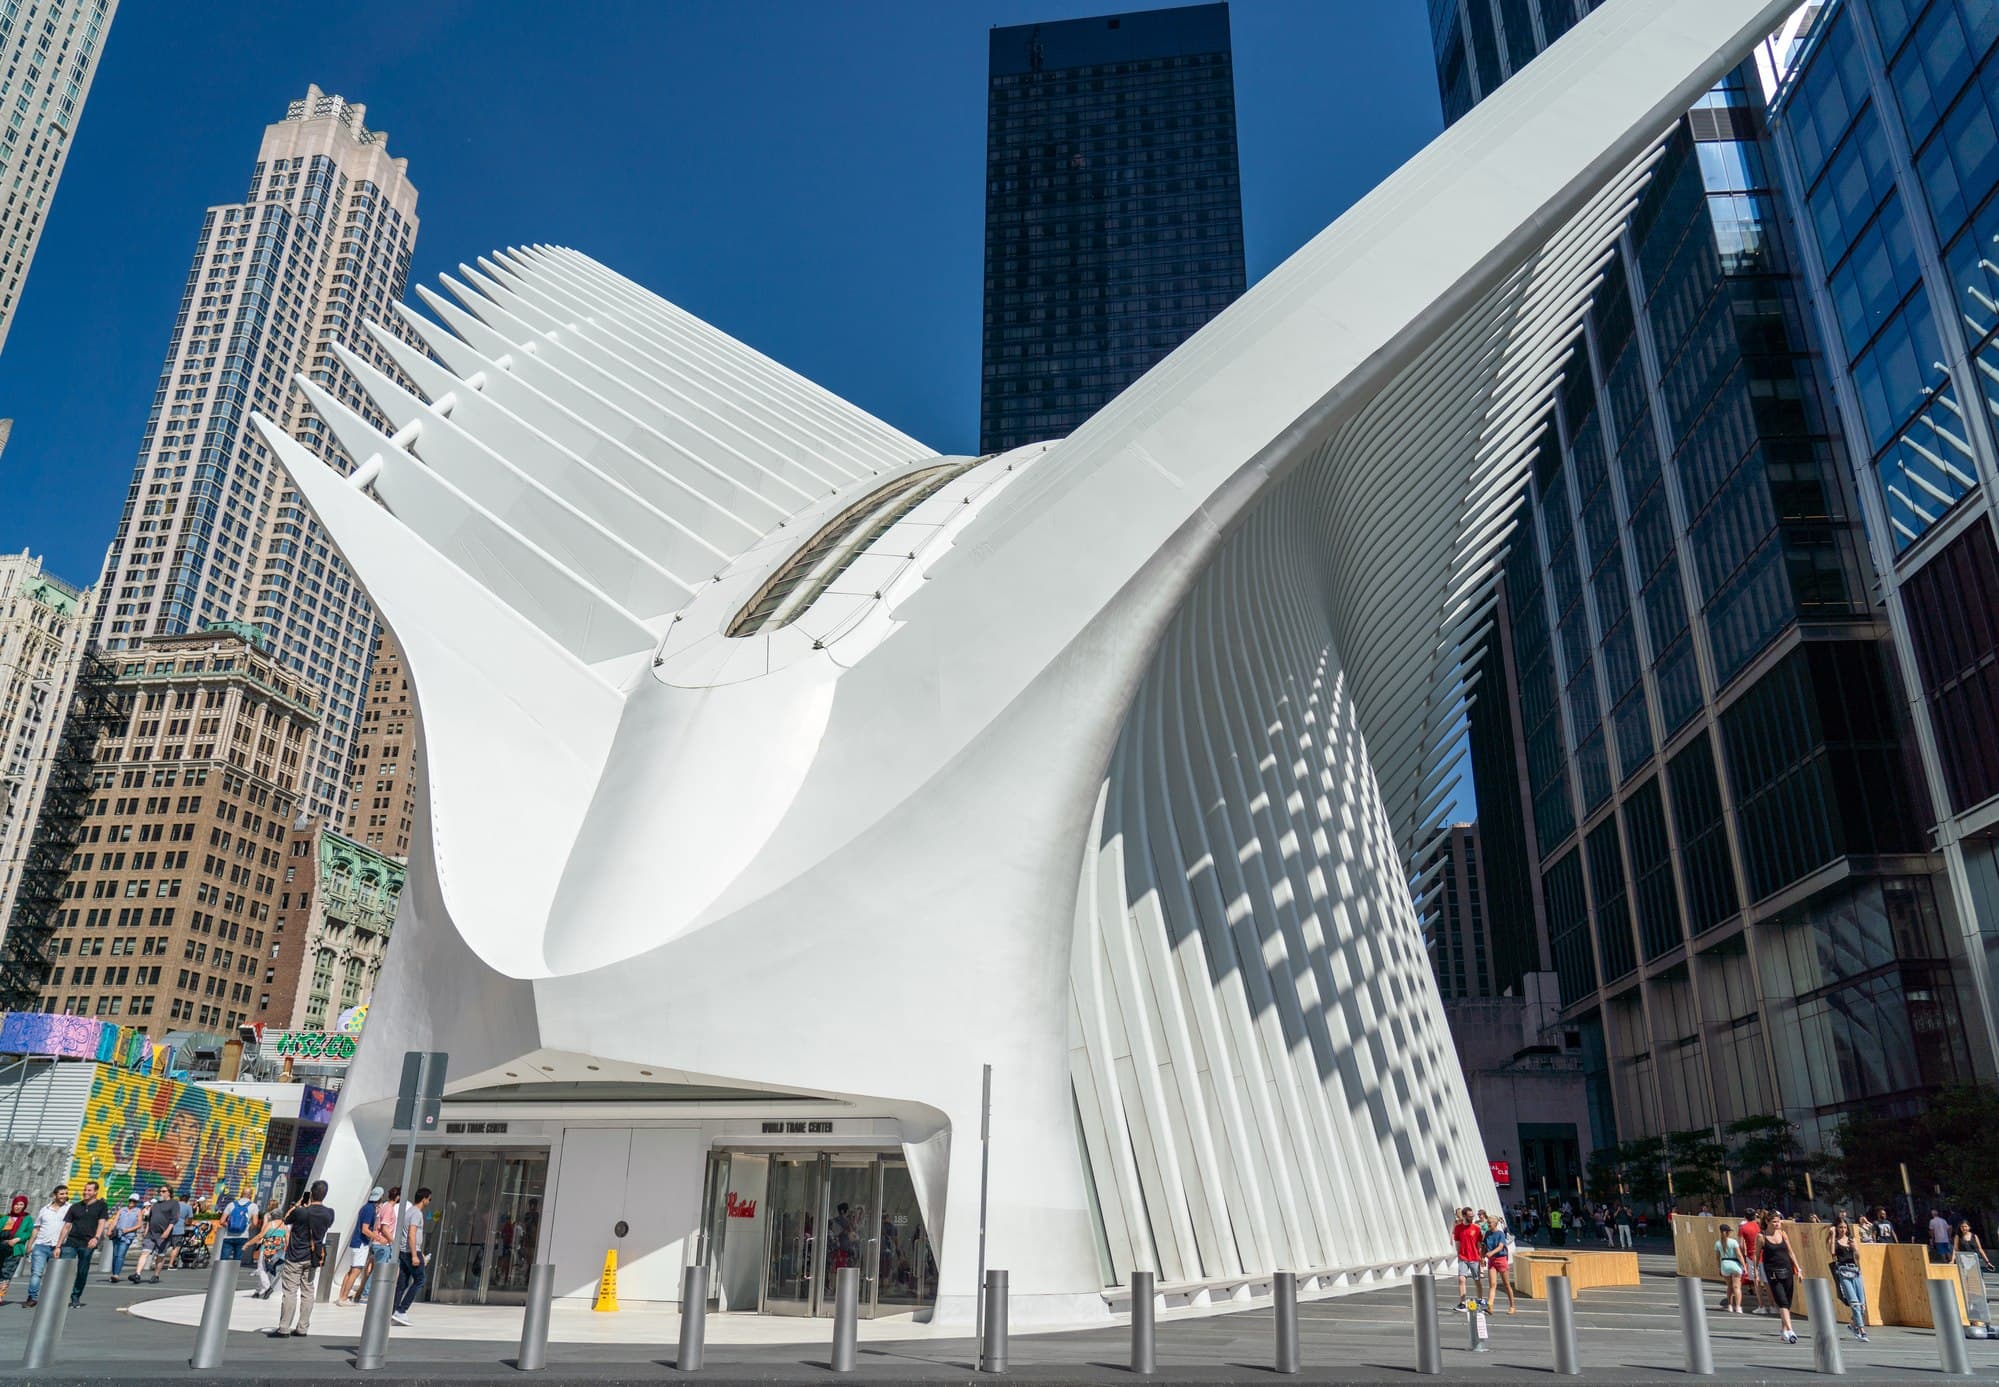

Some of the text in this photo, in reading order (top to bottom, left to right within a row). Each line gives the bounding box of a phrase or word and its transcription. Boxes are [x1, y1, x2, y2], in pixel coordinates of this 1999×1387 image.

[446, 1123, 508, 1133] WORLD TRADE CENTER
[762, 1122, 832, 1133] WORLD TRADE CENTER
[894, 1215, 908, 1224] 185
